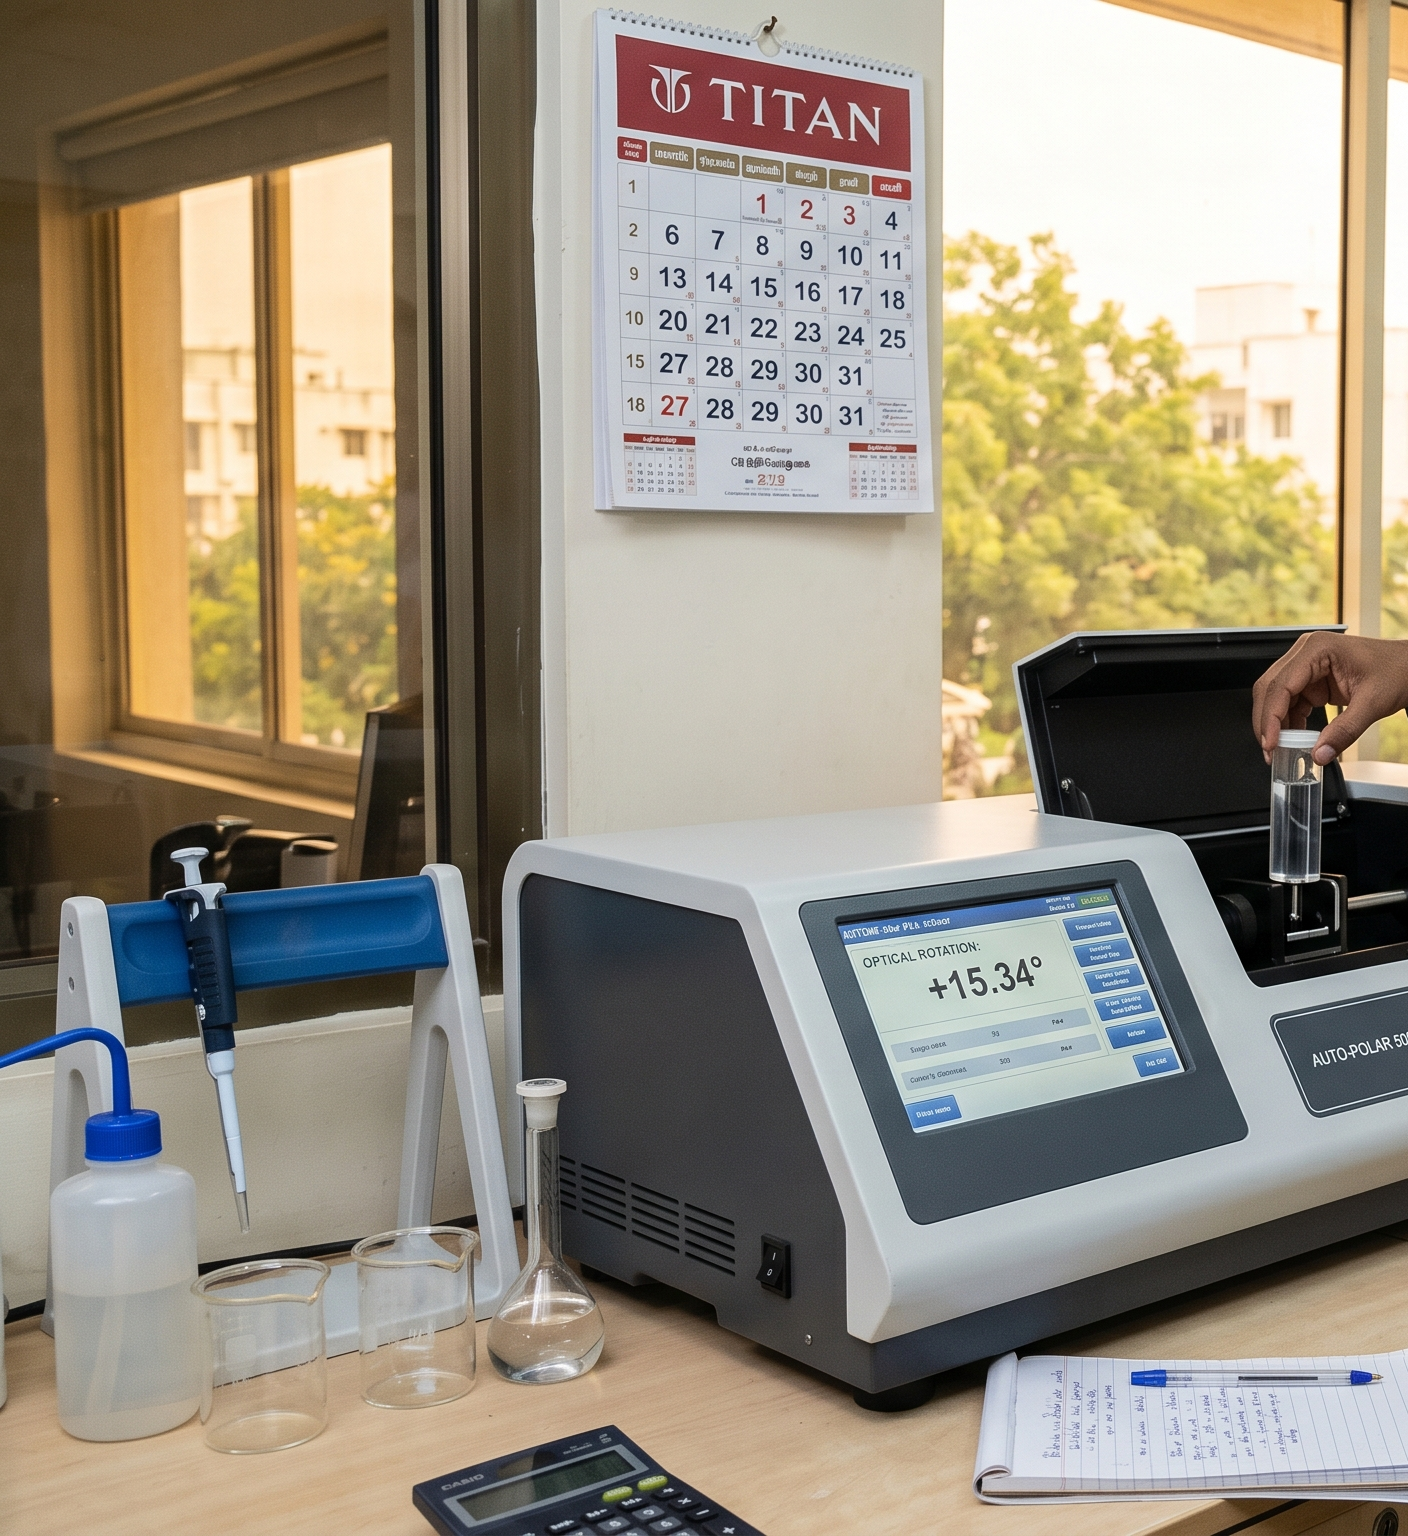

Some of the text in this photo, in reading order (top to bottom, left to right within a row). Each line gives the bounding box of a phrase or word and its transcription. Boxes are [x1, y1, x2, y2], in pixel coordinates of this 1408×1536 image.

[709, 78, 881, 146] TITAN
[628, 179, 636, 194] 1
[756, 193, 766, 214] 1
[800, 199, 814, 221] 2
[843, 205, 856, 225] 3
[885, 211, 898, 231] 4
[629, 222, 901, 270] 2 6 7 8 9 10 11
[629, 266, 905, 310] 9 13 14 15 16 17 18
[625, 309, 906, 349] 10 20 21 22 23 24 25
[626, 352, 862, 386] 15 27 28 29 30 31
[627, 396, 645, 412] 18
[661, 395, 689, 417] 27
[706, 398, 734, 420] 28
[751, 401, 779, 422] 29
[795, 403, 823, 425] 30
[839, 405, 863, 426] 31
[862, 941, 981, 969] OPTICAL ROTATION:
[928, 956, 1043, 1001] +15.34°
[1312, 1036, 1393, 1067] AUTO-POLAR
[442, 1474, 484, 1491] CASIO
